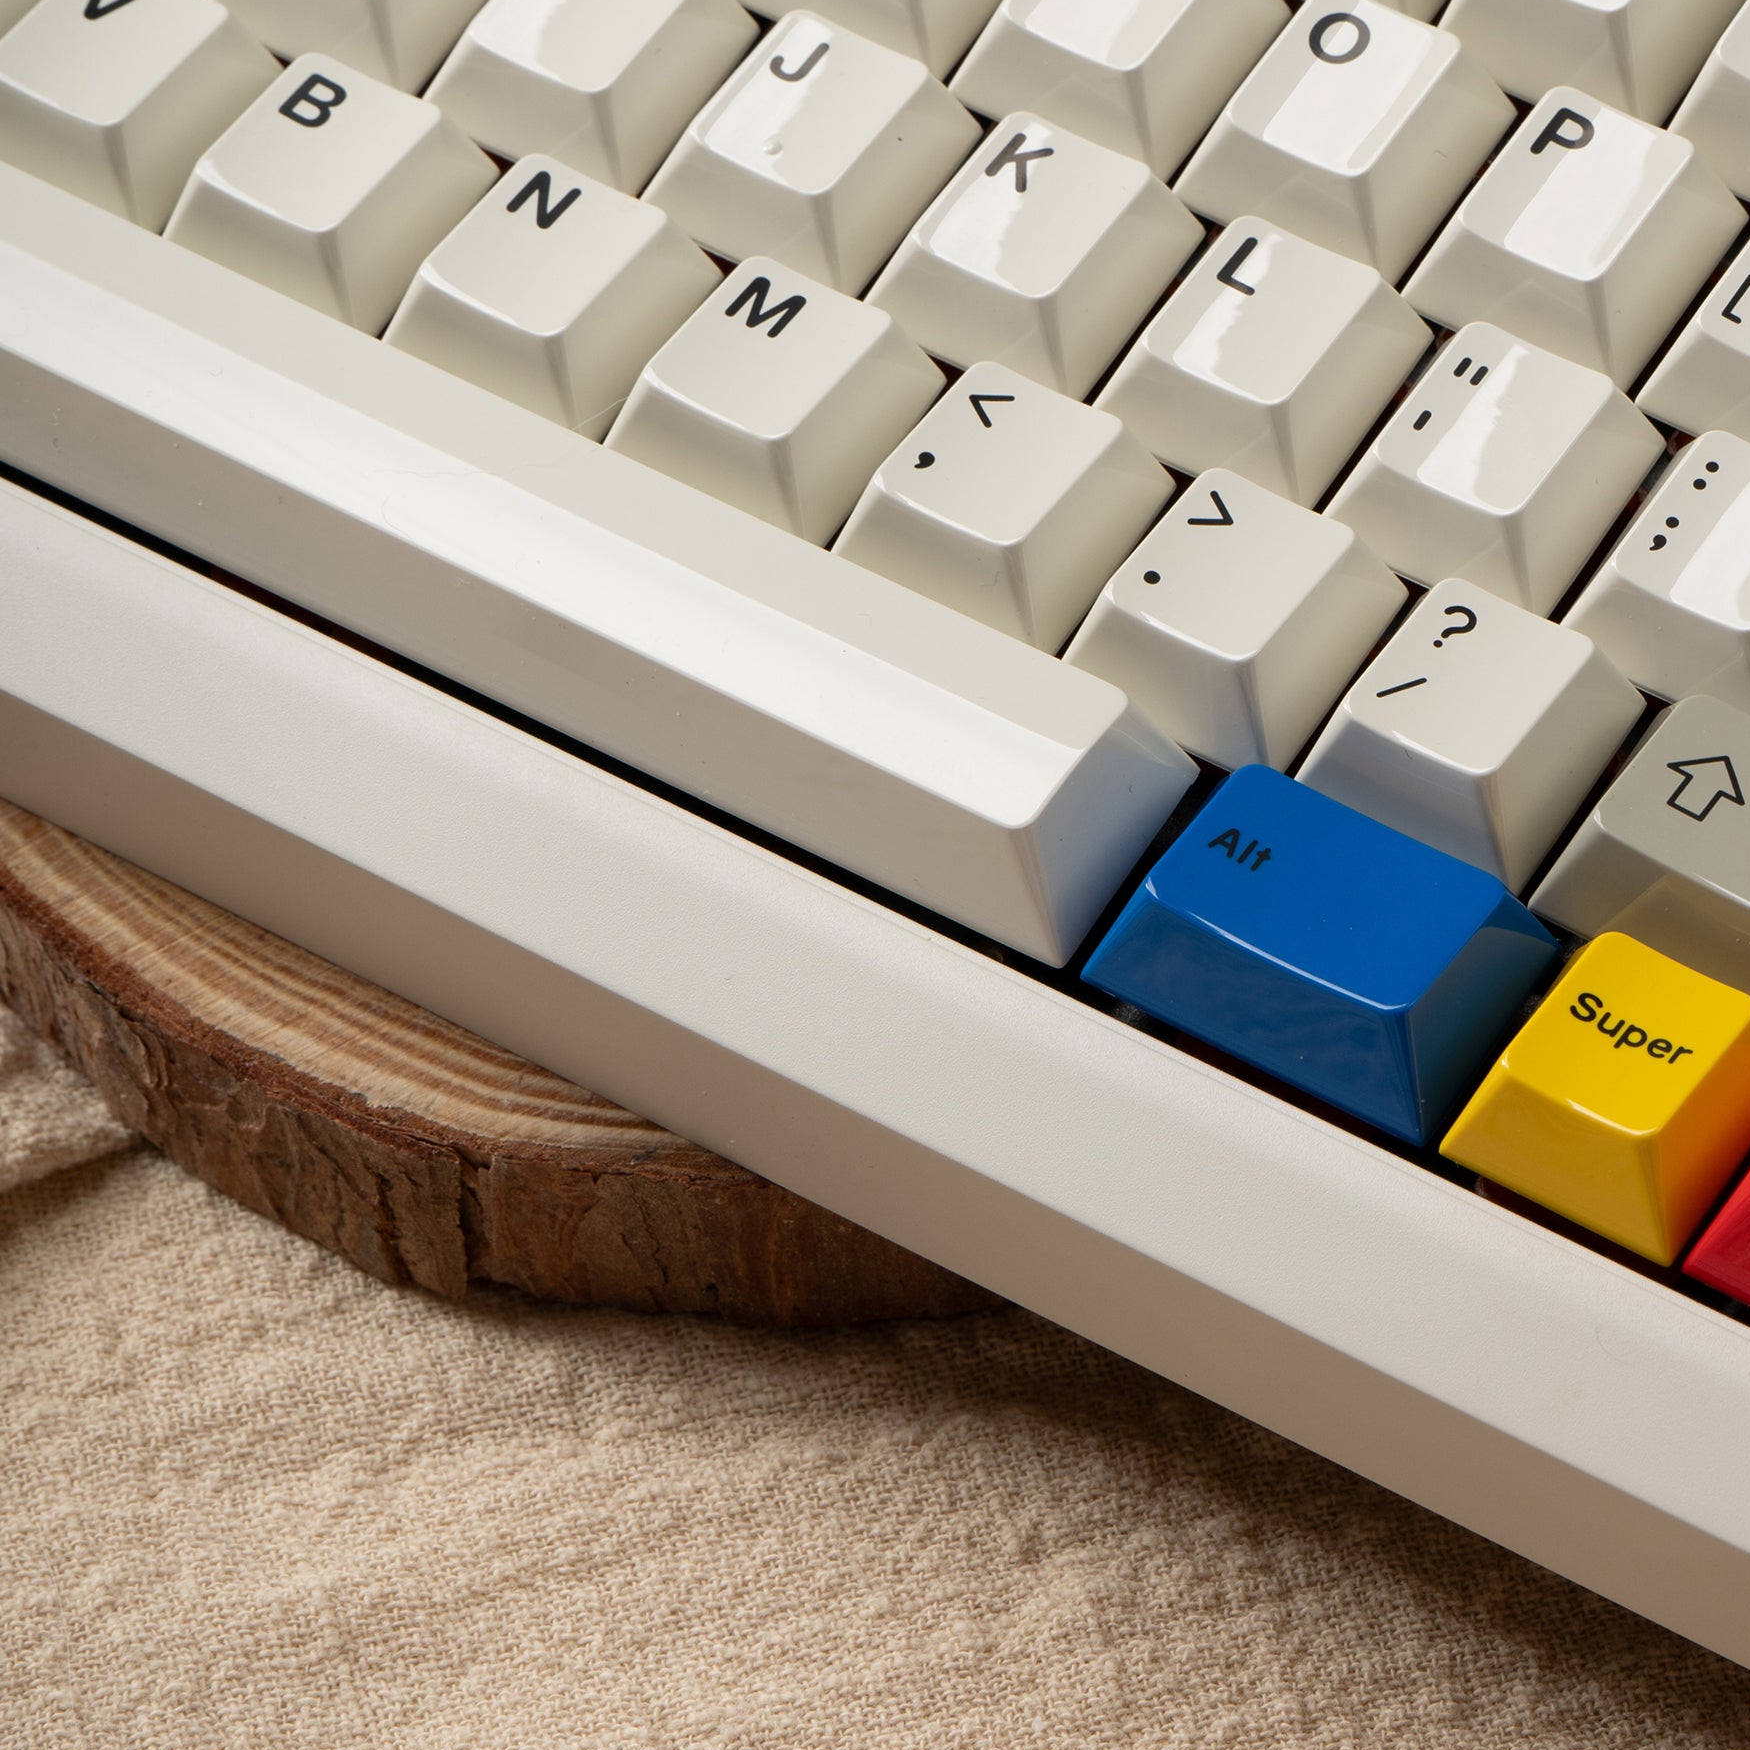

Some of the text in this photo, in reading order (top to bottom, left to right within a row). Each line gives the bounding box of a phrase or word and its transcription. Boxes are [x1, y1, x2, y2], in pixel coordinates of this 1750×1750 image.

[768, 41, 832, 84] J
[1307, 11, 1372, 66] O
[277, 72, 348, 129] B
[1528, 106, 1596, 156] P
[983, 131, 1056, 195] K
[505, 169, 583, 231] N
[1215, 235, 1260, 297] L
[723, 275, 808, 340] M
[1206, 826, 1273, 873] Alt
[1568, 991, 1695, 1066] Super
